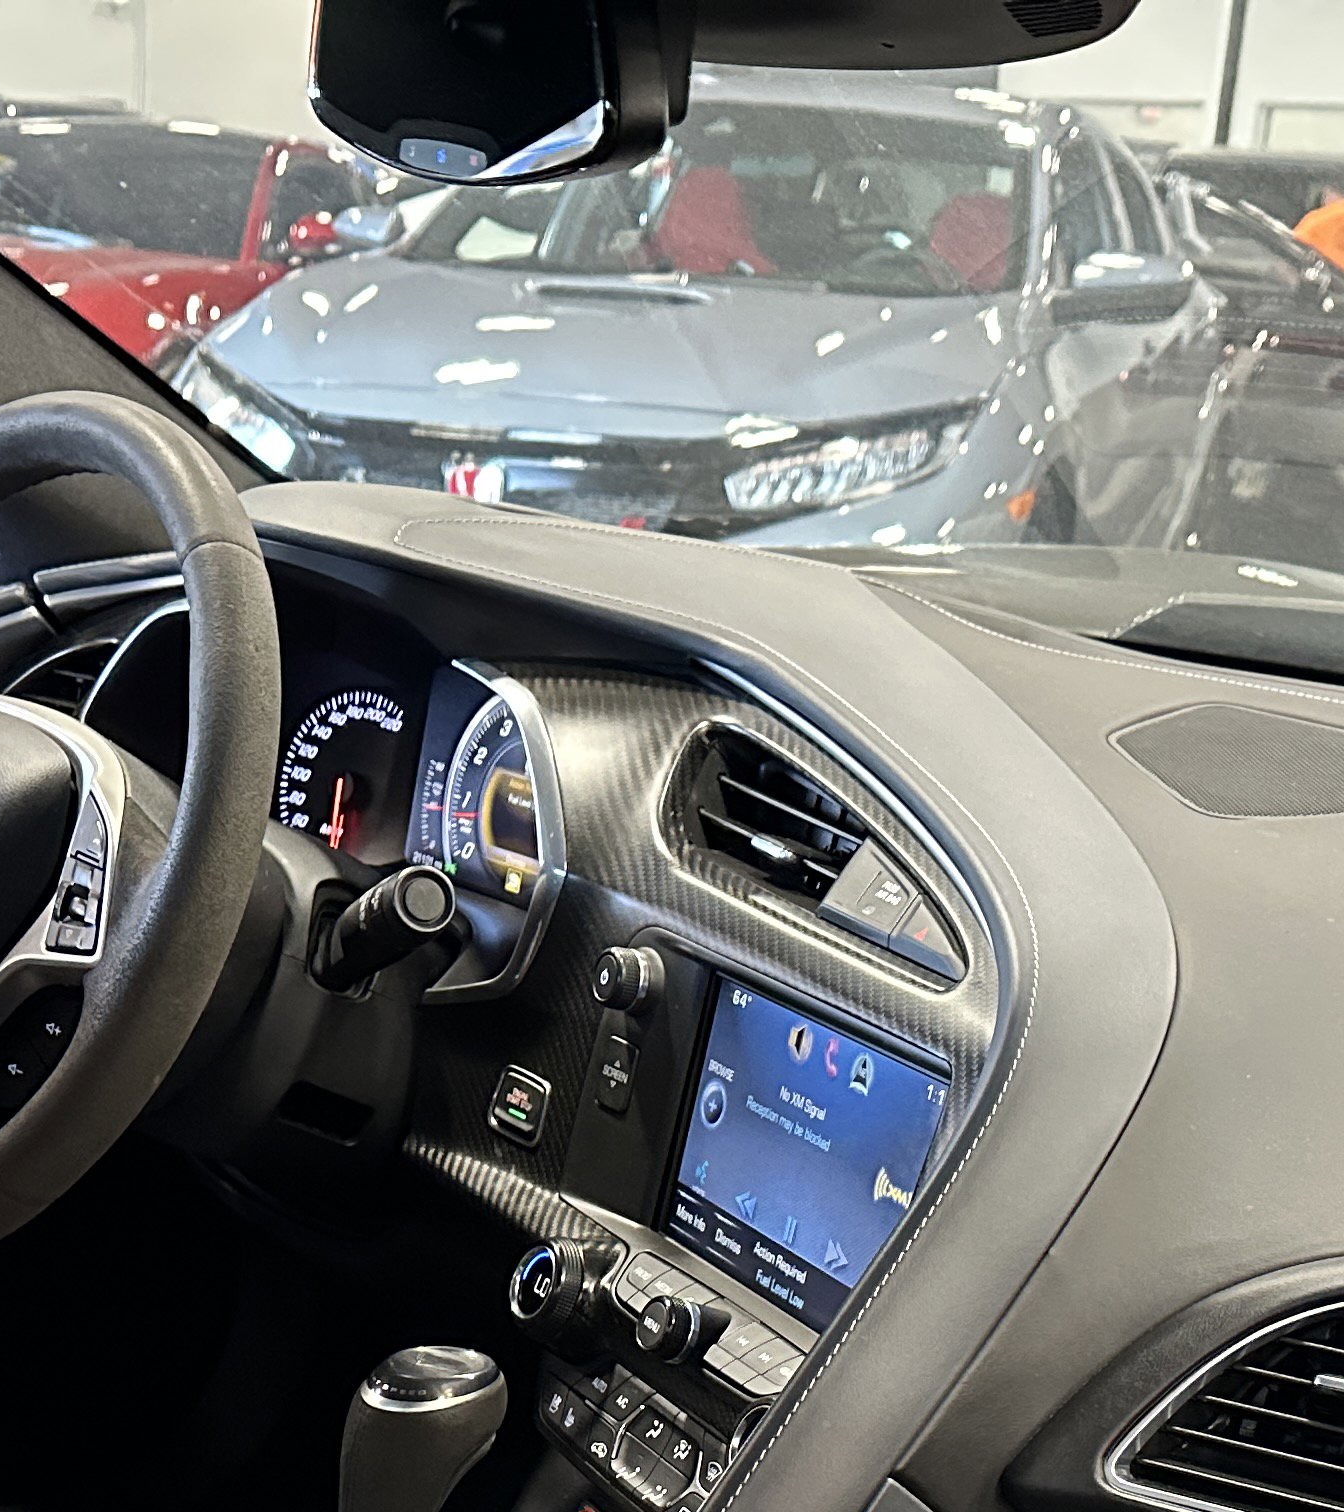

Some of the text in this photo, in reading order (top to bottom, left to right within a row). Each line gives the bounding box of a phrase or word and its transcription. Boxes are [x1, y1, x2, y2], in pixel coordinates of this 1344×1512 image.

[364, 707, 386, 722] 200
[499, 719, 514, 737] 3
[473, 746, 488, 766] 2
[290, 765, 312, 782] 100
[602, 1064, 629, 1085] SCREEN
[779, 1085, 827, 1121] No XM Signal
[746, 1095, 831, 1152] Reception may be blocked
[676, 1203, 706, 1232] More Info
[715, 1227, 742, 1255] Dismiss
[753, 1241, 808, 1284] Action Required
[755, 1268, 805, 1310] Fuel Level Low
[643, 1315, 661, 1334] MENU
